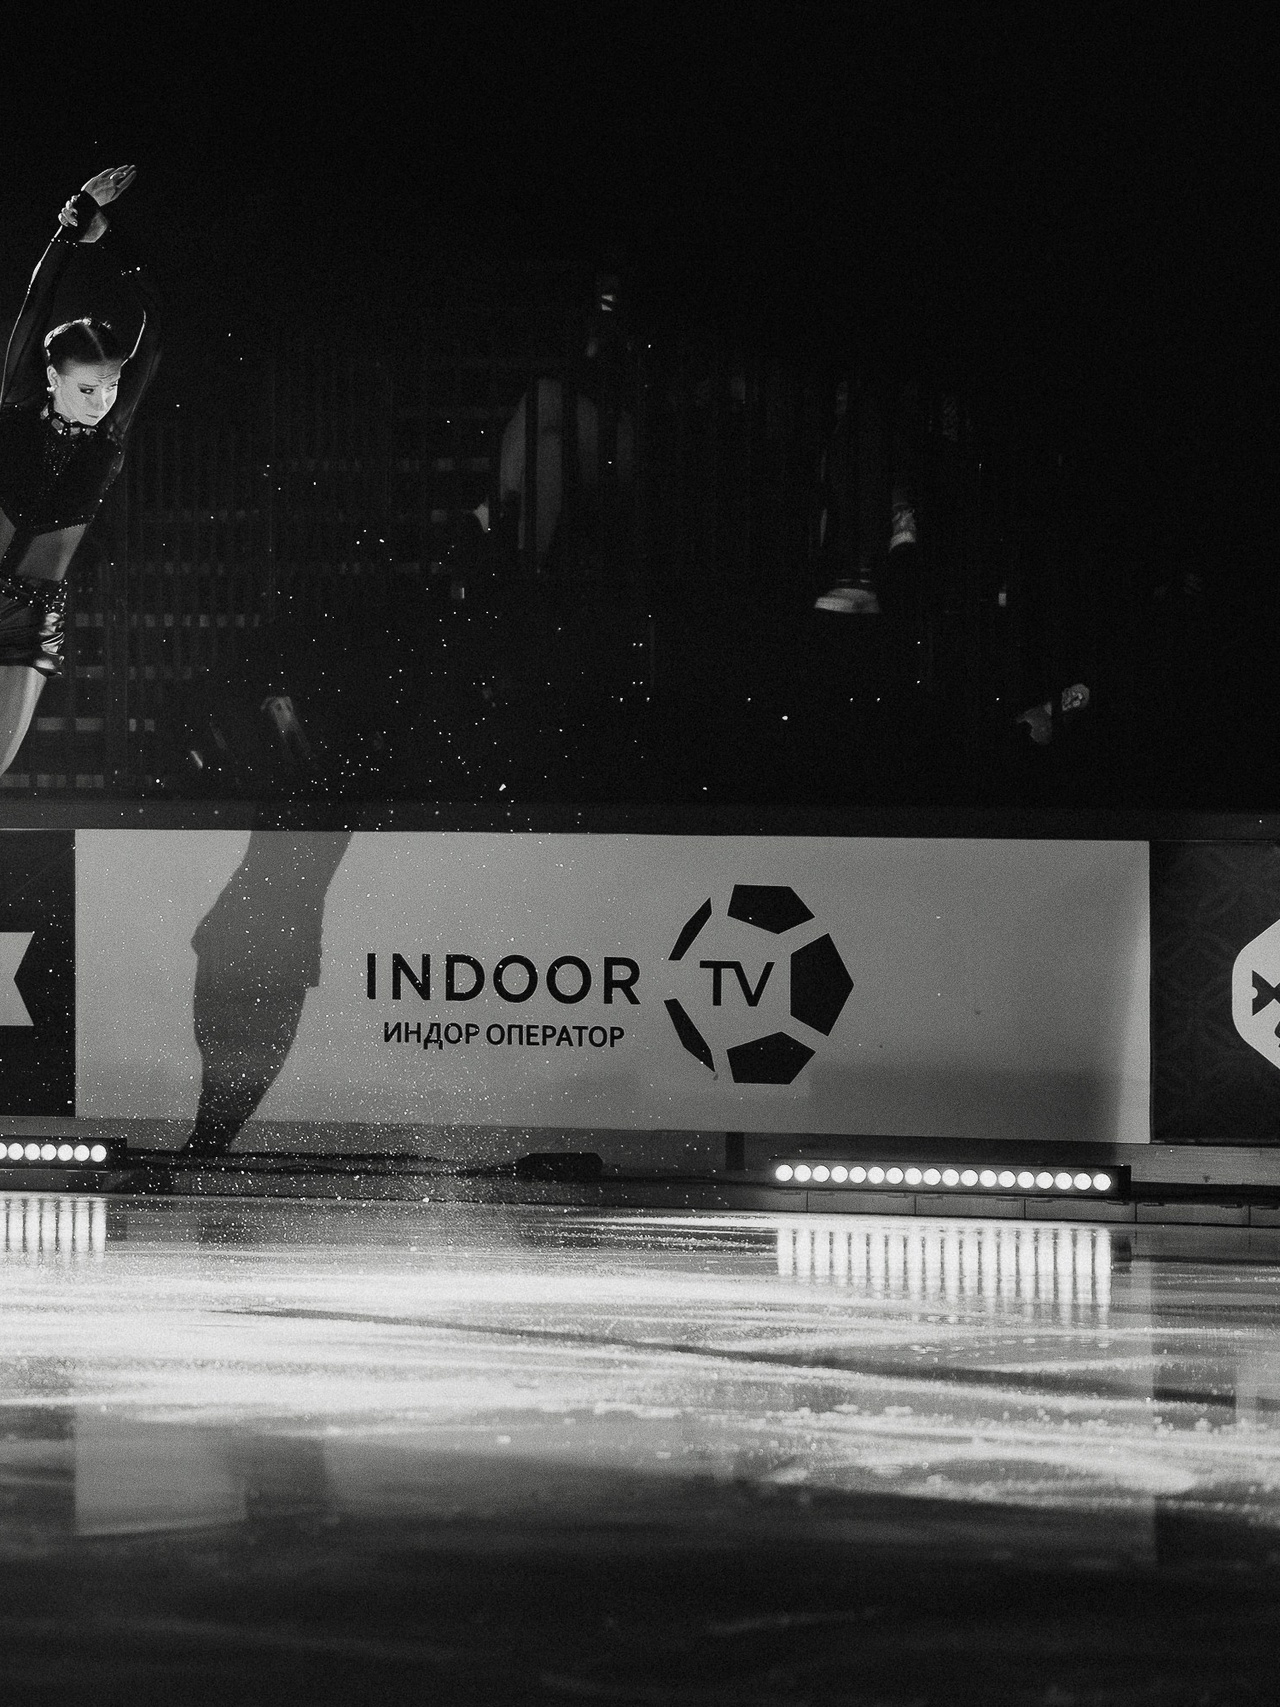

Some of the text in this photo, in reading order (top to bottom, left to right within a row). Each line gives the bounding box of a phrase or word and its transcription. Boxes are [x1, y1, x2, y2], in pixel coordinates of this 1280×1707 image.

[367, 953, 775, 1006] INDOOR TV
[383, 1022, 625, 1049] ИНДОР ОПЕРАТОР
